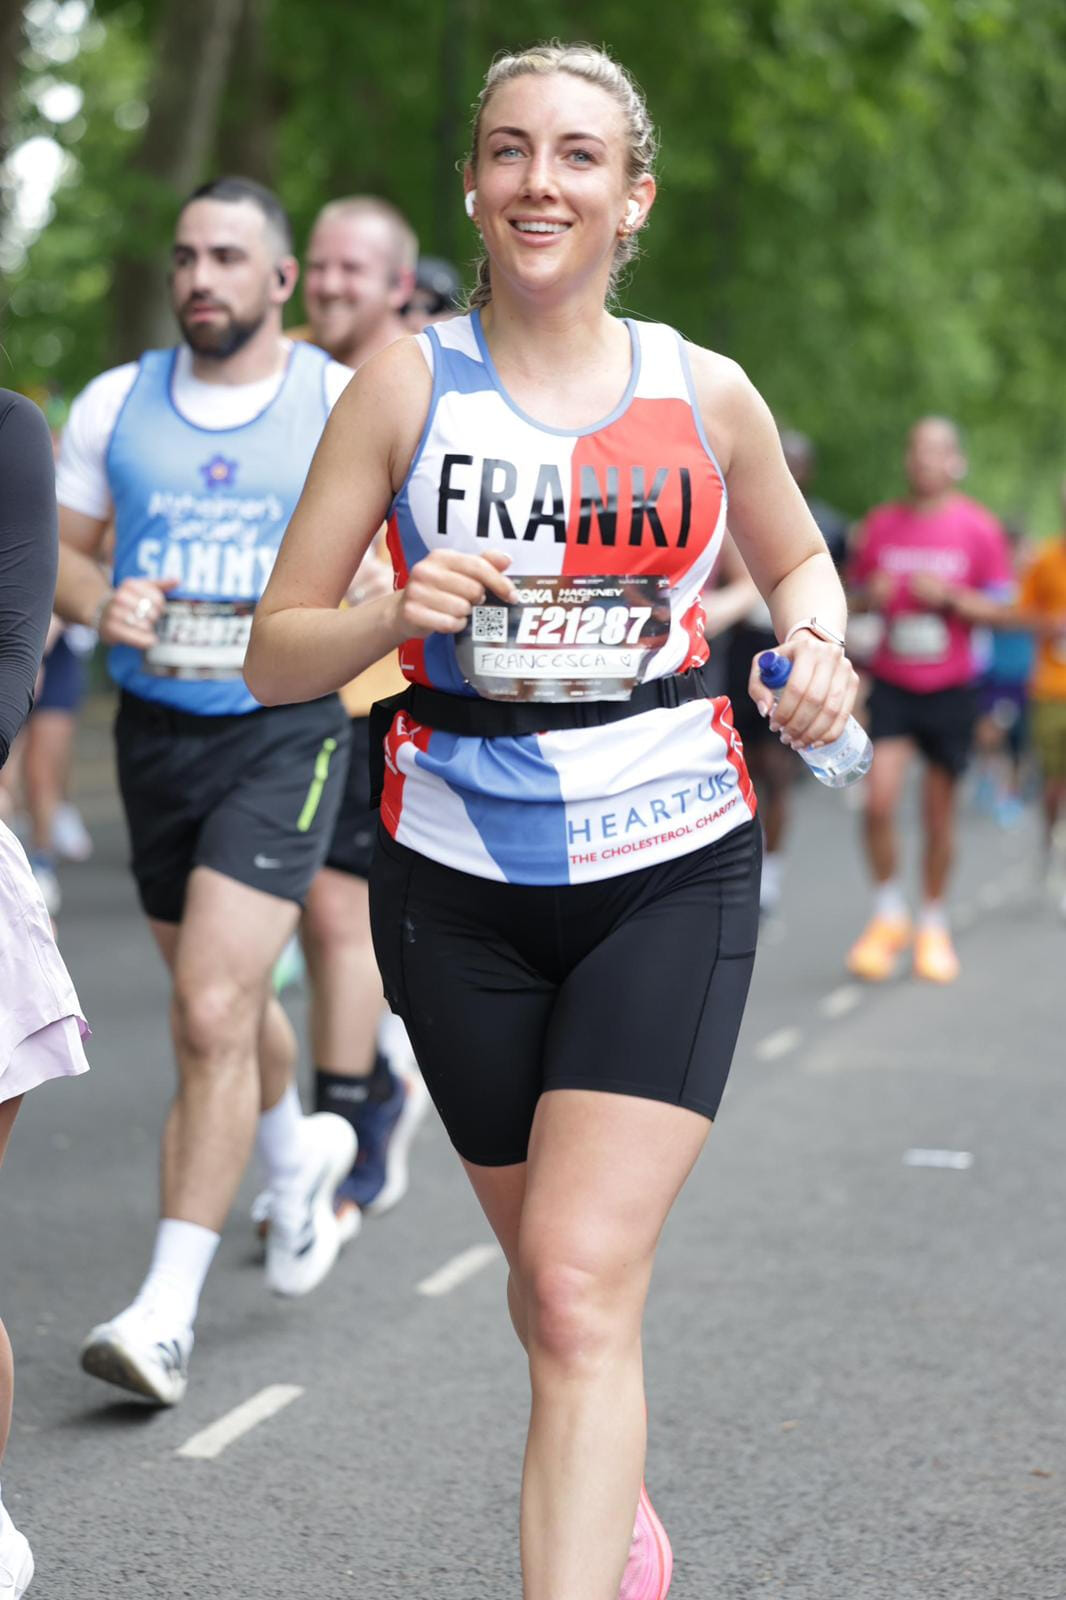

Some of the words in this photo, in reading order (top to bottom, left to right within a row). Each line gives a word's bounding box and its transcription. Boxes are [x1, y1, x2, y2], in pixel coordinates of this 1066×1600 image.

[437, 454, 692, 548] FRANKI
[516, 588, 554, 604] OKA
[558, 588, 624, 598] HACKNEY
[515, 606, 652, 645] E21287
[480, 651, 607, 670] FRANCESCA
[567, 788, 692, 845] HEART
[697, 768, 735, 802] UK
[569, 852, 598, 865] THE
[601, 824, 693, 861] CHOLESTEROL
[695, 796, 738, 830] CHARITY
